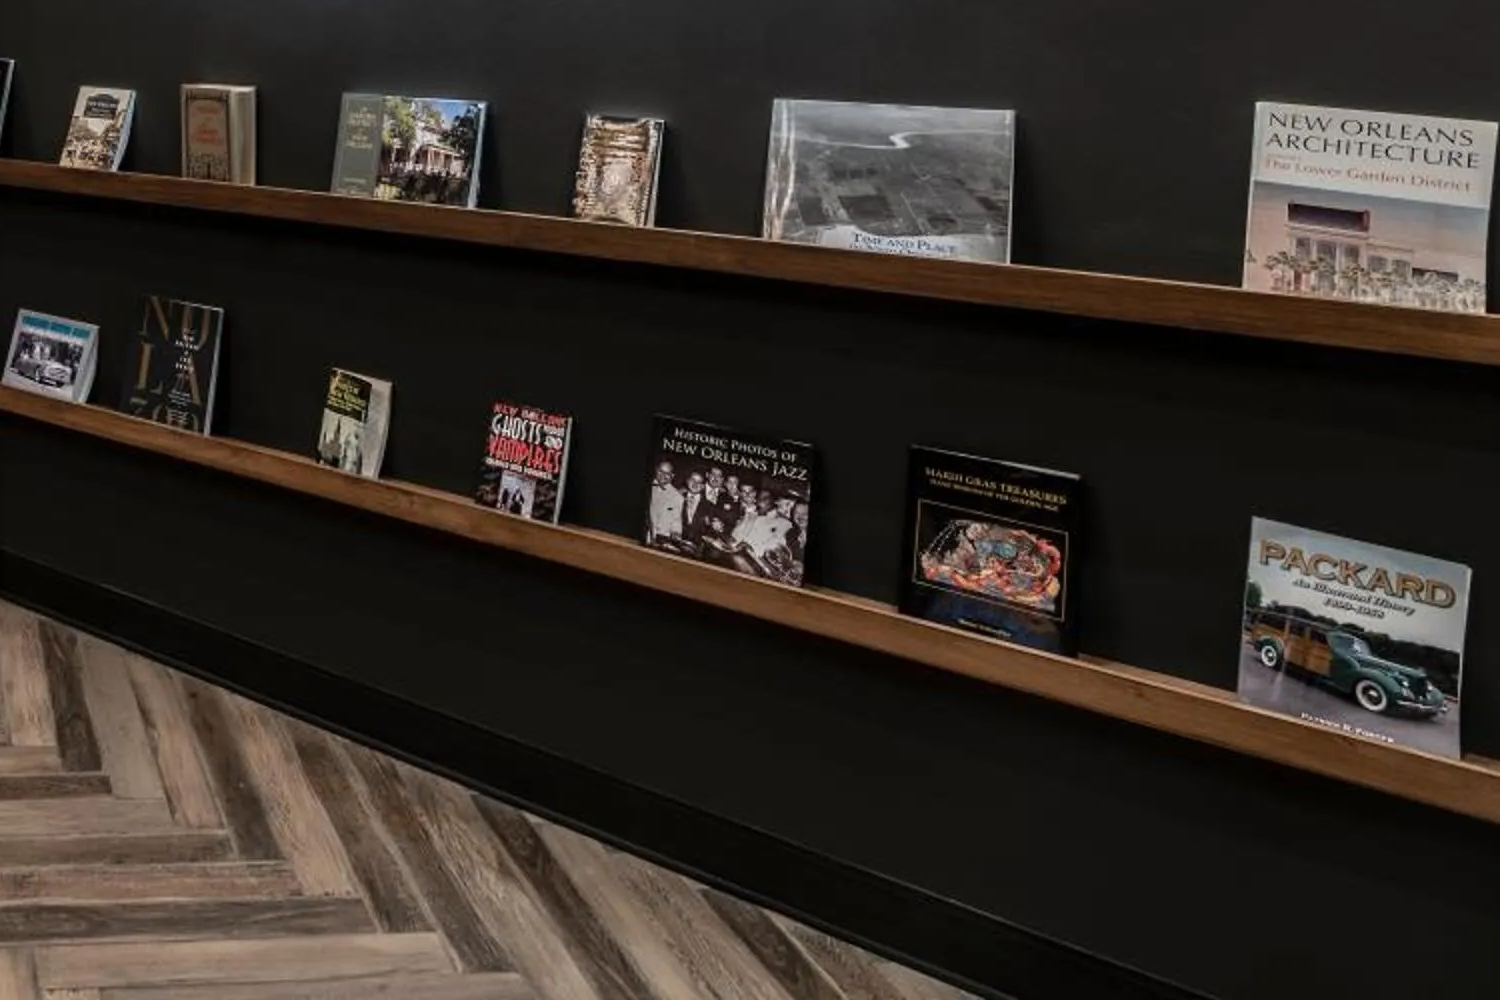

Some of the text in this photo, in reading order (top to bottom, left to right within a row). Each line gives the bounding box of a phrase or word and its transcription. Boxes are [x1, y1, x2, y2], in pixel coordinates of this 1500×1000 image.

[1268, 111, 1475, 147] NEW ORLEANS
[1265, 133, 1481, 169] ARCHITECTURE
[1347, 167, 1406, 184] Garden
[1411, 174, 1471, 192] District
[491, 413, 543, 446] GHOSTS
[673, 427, 798, 463] HISTORIC PHOTOS OF
[662, 437, 808, 481] NEW ORLEANS JAZZ
[1257, 538, 1457, 609] PACKARD
